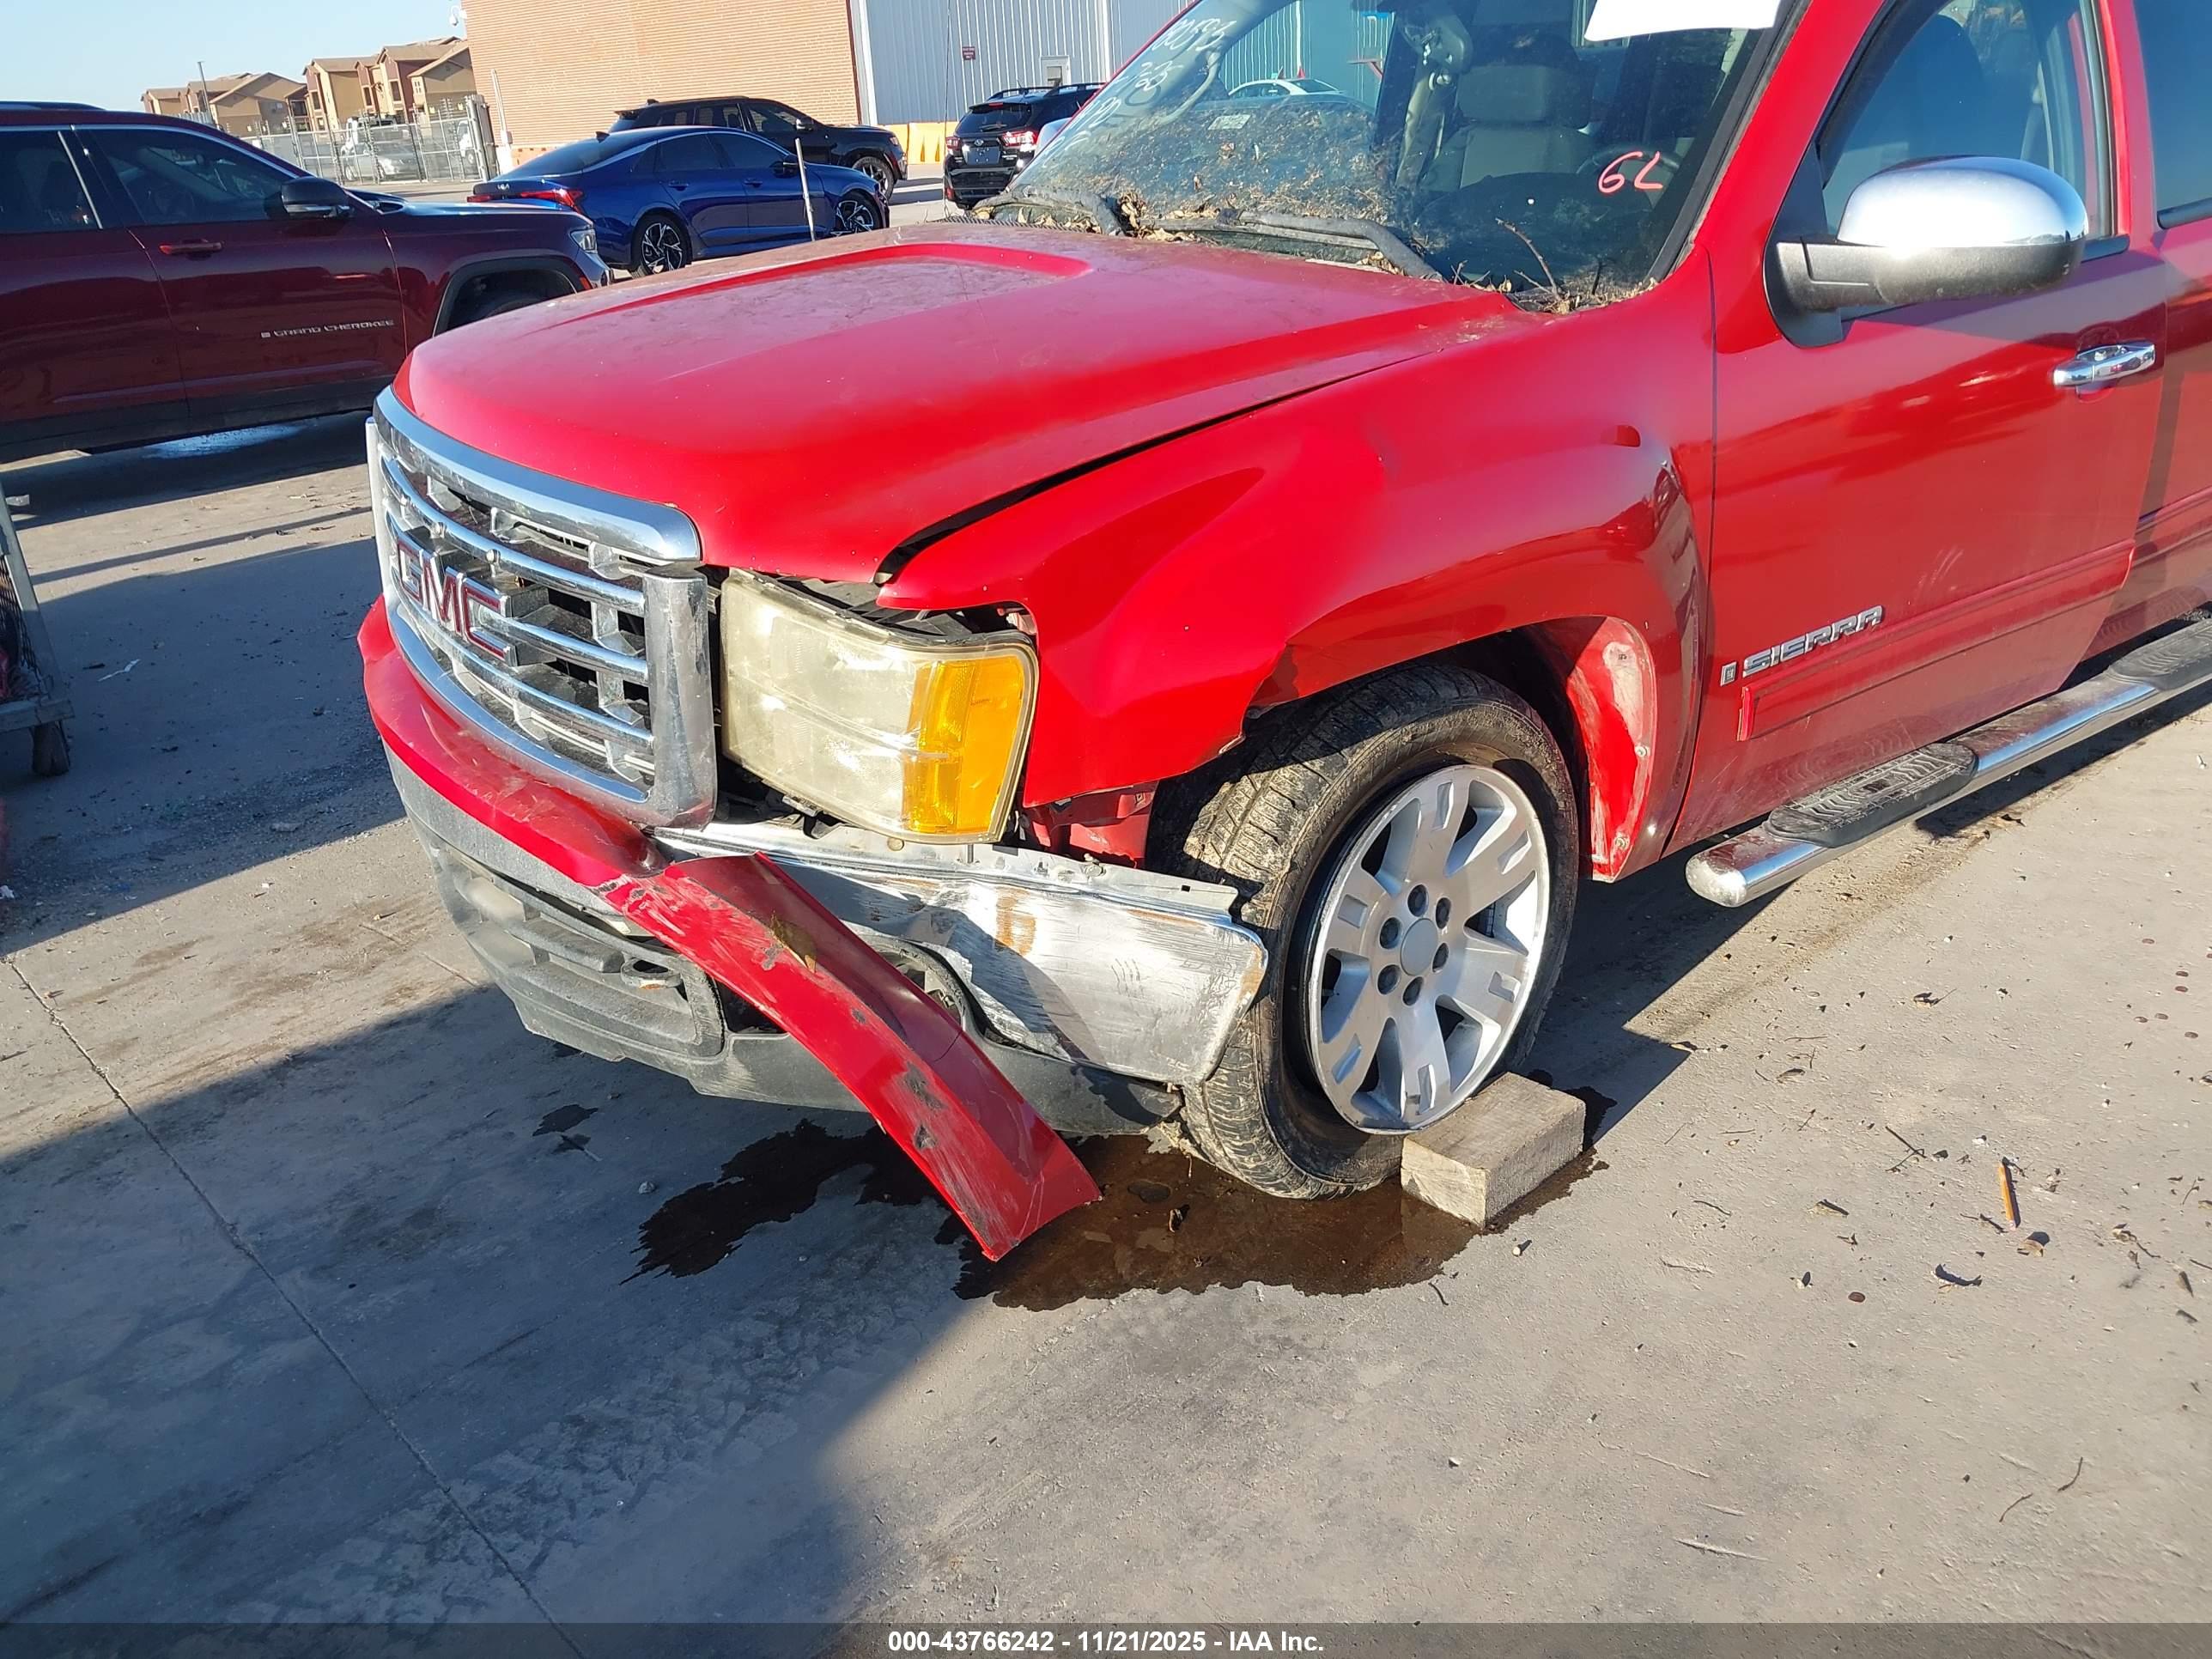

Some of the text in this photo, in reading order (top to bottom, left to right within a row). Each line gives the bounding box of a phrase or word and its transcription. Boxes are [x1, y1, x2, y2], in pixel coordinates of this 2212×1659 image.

[273, 319, 395, 337] GRAND CHEROKEE
[398, 538, 513, 665] GMC
[1742, 605, 1884, 678] SIERRA
